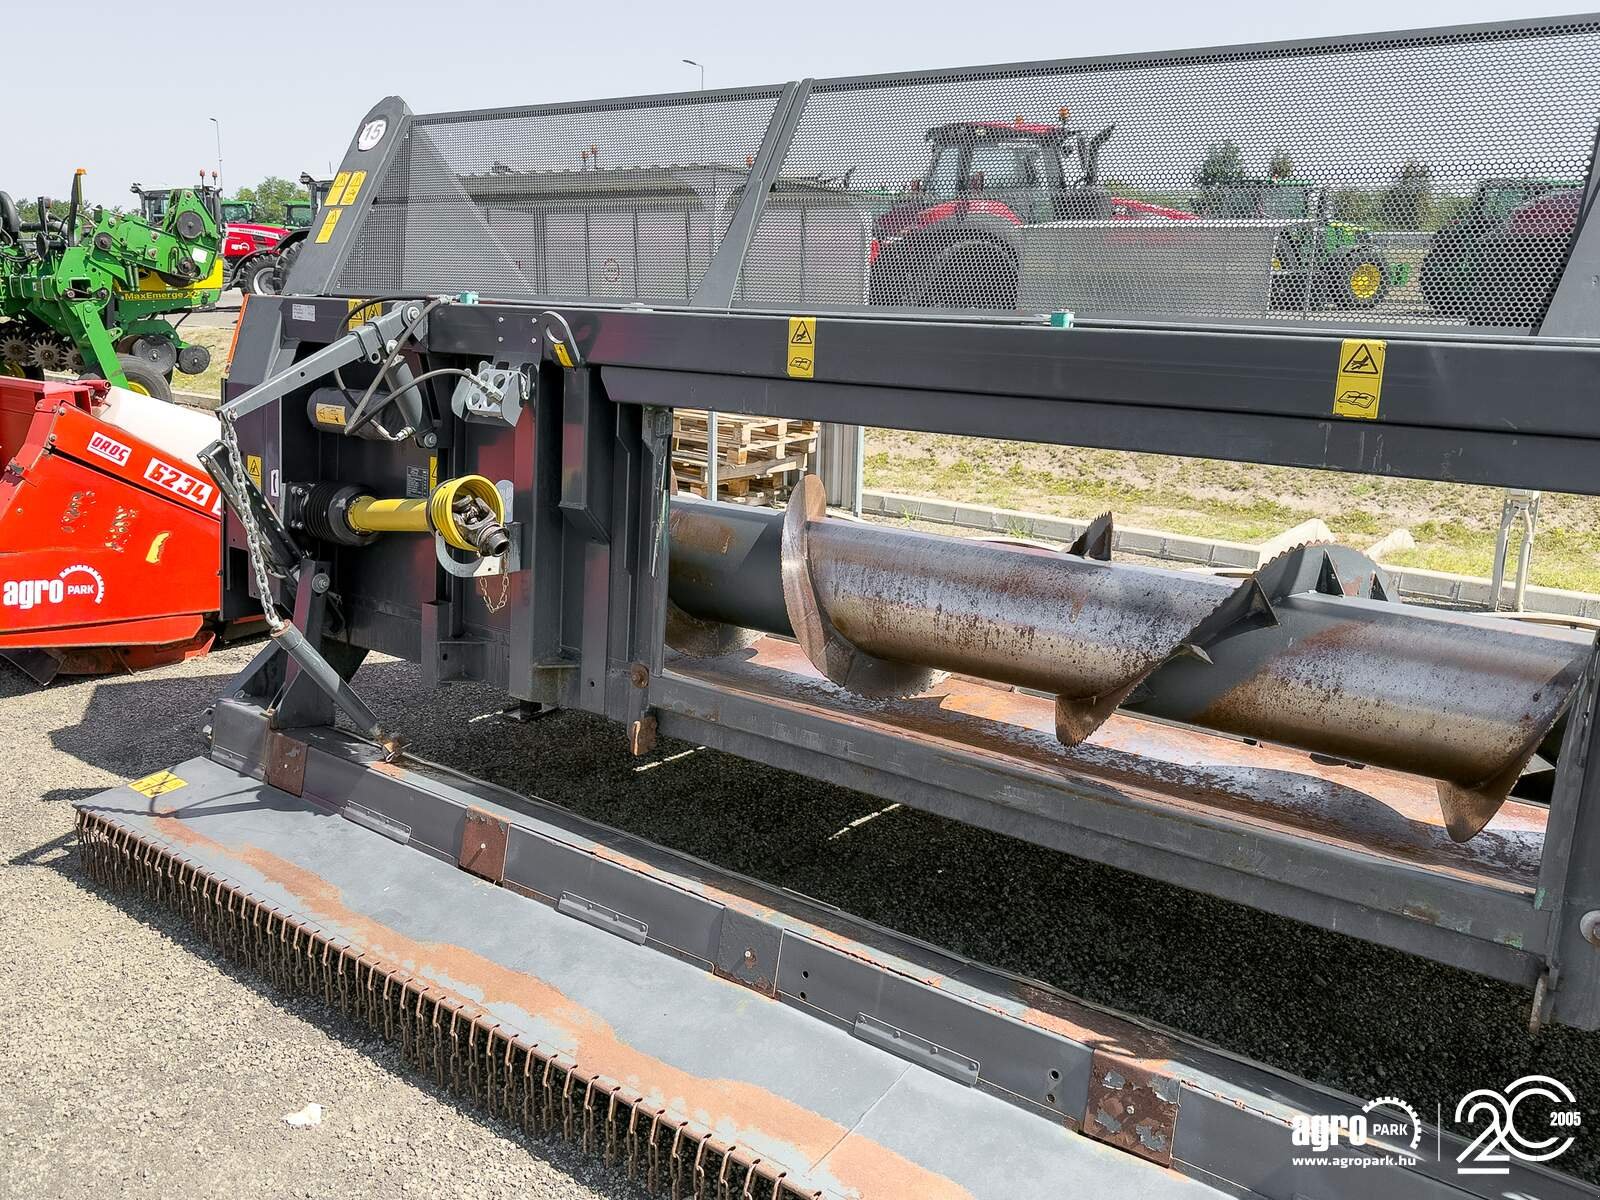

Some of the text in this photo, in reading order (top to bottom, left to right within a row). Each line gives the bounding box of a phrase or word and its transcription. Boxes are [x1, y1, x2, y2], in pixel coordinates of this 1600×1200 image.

[364, 123, 384, 141] 15
[124, 291, 184, 300] MaxEmerge
[91, 436, 129, 462] OROS
[148, 462, 206, 502] 6234
[3, 579, 94, 610] agro PARK
